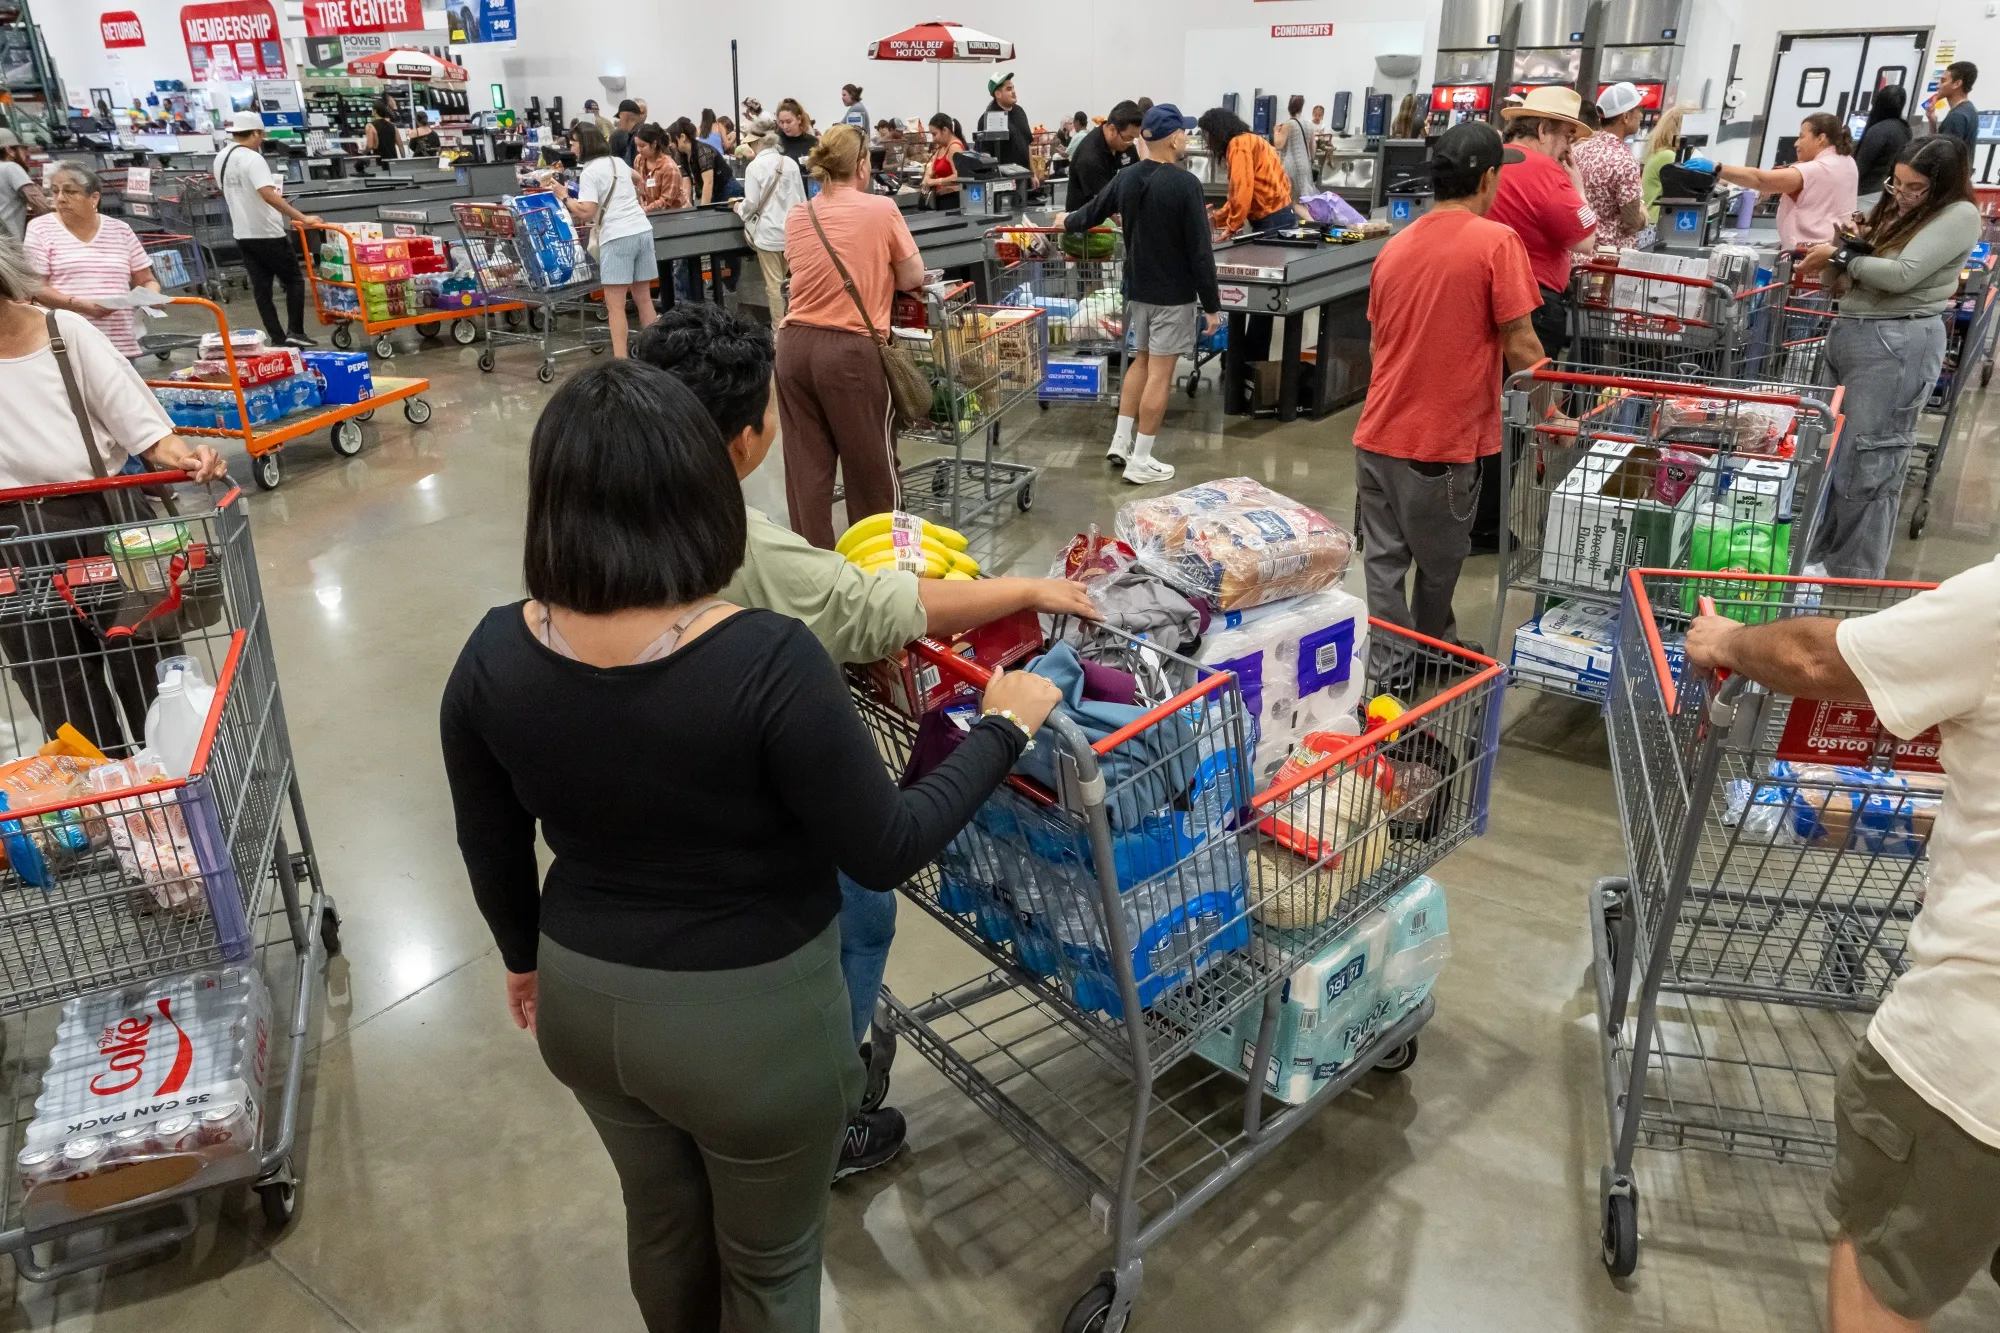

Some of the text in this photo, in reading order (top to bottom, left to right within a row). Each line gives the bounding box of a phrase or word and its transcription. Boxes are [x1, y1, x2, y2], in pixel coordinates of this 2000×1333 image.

[315, 0, 408, 29] TIRE CENTER
[102, 20, 142, 41] RETURNS
[186, 13, 272, 43] MEMBERSHIP
[1274, 25, 1330, 37] CONDIMENTS
[343, 36, 381, 46] POWER
[890, 41, 944, 49] 100% ALL BEEF
[896, 49, 937, 57] HOT DOGS
[398, 64, 431, 72] KIRKLAND
[128, 178, 149, 191] CLOSED
[366, 244, 383, 253] poppi
[369, 263, 387, 272] poppi
[1219, 267, 1236, 275] ITEMS
[1245, 268, 1260, 277] CART
[1267, 286, 1281, 312] 3
[258, 358, 285, 377] Coca-Cola
[347, 361, 369, 373] PEPSI
[1587, 524, 1607, 572] Broccoli
[1634, 537, 1647, 568] KIRKLAN
[1549, 613, 1572, 630] Ensure
[1812, 705, 1829, 737] WARNING
[1807, 737, 1868, 752] COSTCO
[97, 1027, 115, 1049] Diet
[89, 1012, 154, 1096] Coke
[66, 1093, 211, 1135] 35 CAN PACK
